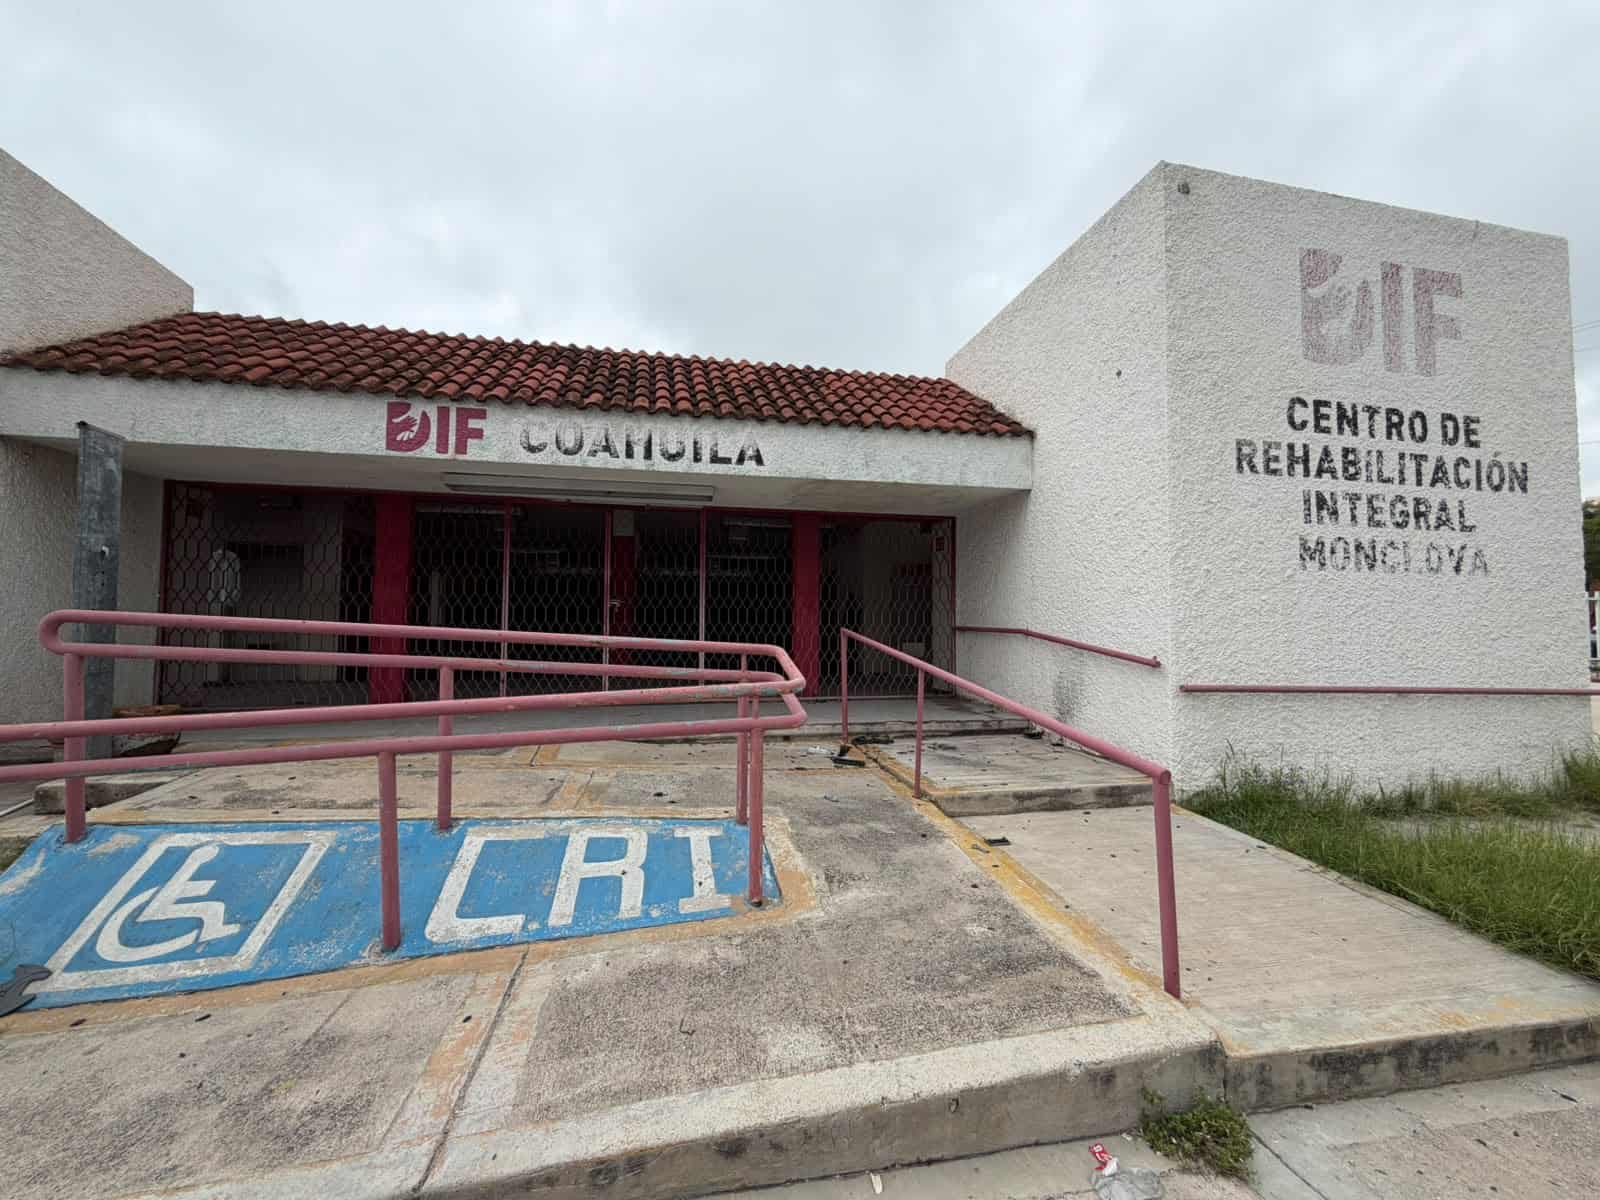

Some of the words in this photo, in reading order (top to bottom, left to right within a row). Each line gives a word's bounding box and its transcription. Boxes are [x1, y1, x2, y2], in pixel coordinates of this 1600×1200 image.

[386, 402, 487, 455] DIF
[518, 421, 765, 467] COAHUILA
[1286, 397, 1428, 443] CENTRO
[1440, 412, 1481, 448] DE
[1235, 438, 1529, 494] REHABILITACIÓN
[1302, 489, 1477, 532] INTEGRAL
[425, 826, 732, 943] CRI
